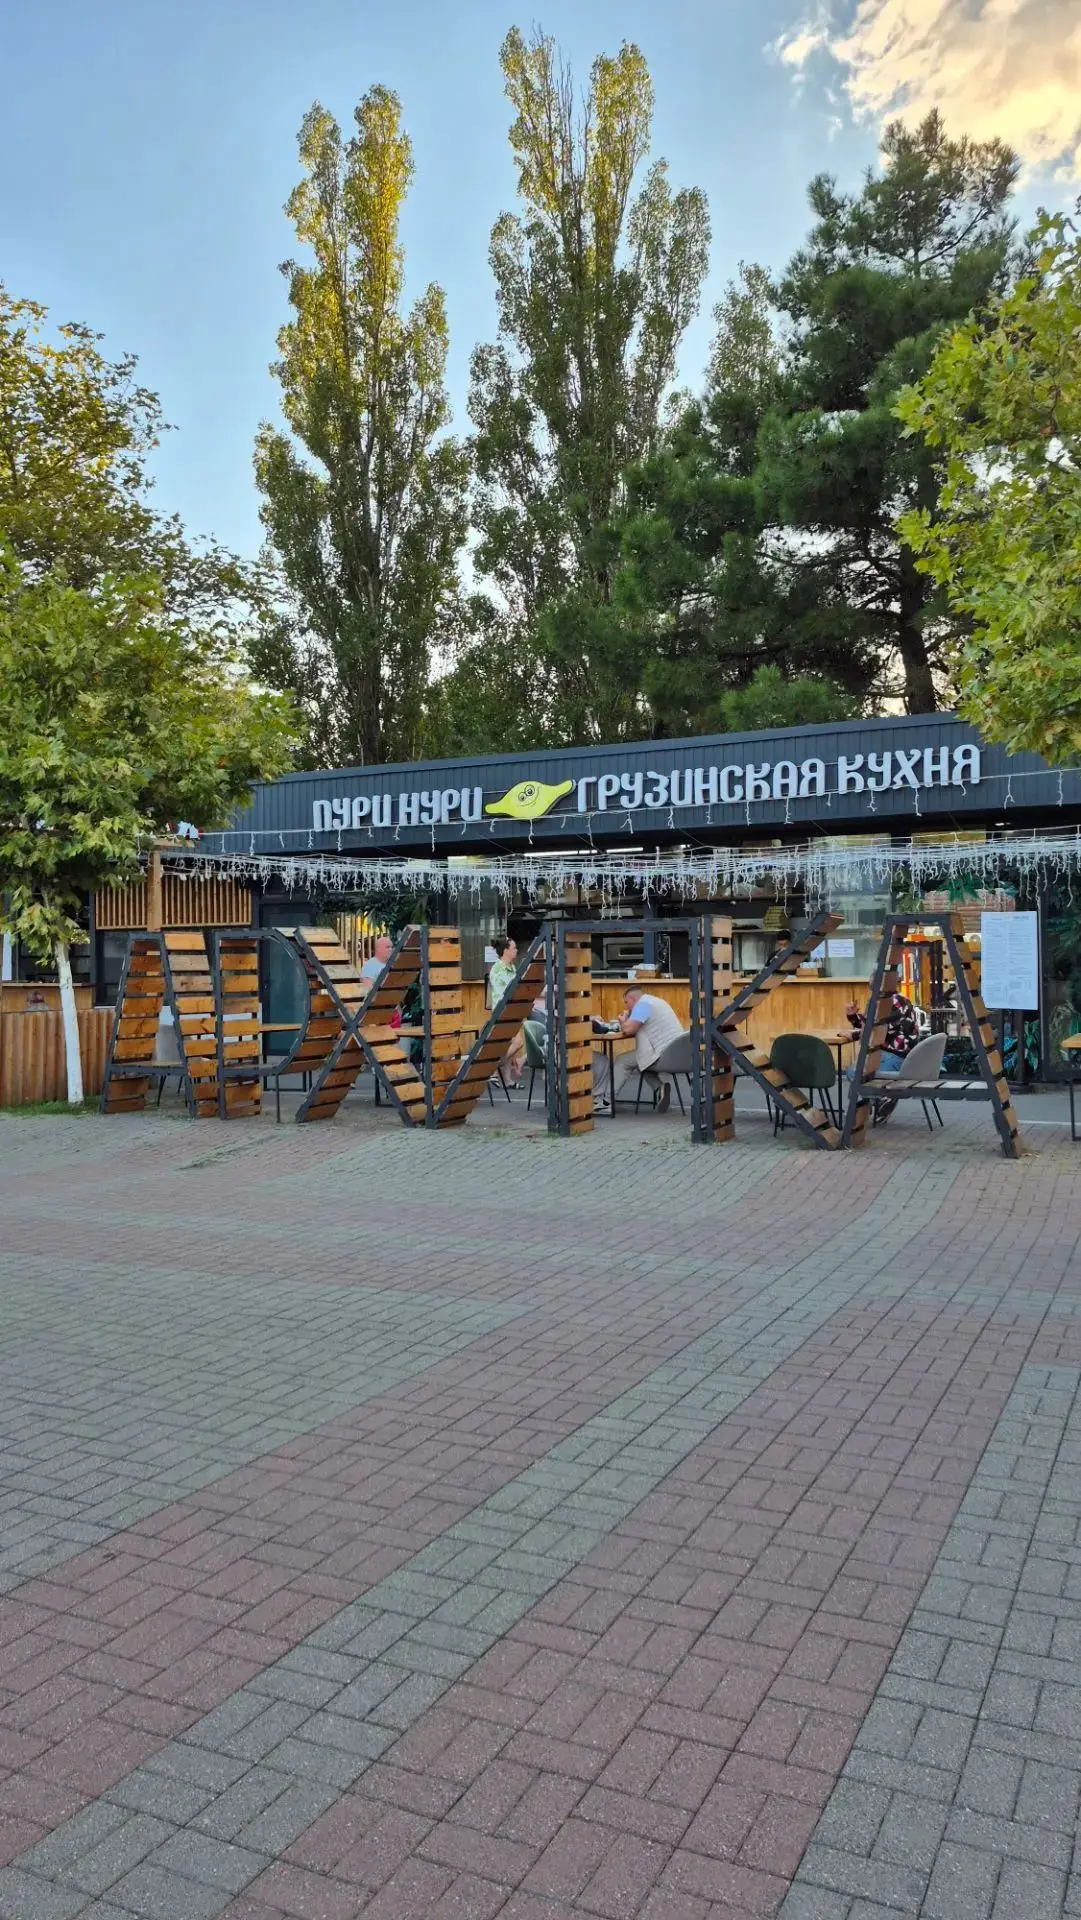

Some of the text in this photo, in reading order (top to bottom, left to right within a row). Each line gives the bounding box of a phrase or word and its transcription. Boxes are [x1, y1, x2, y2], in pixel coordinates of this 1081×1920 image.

[312, 744, 981, 832] ПУРИ НУРИ ГРУЗИНСКАЯ КУХНЯ
